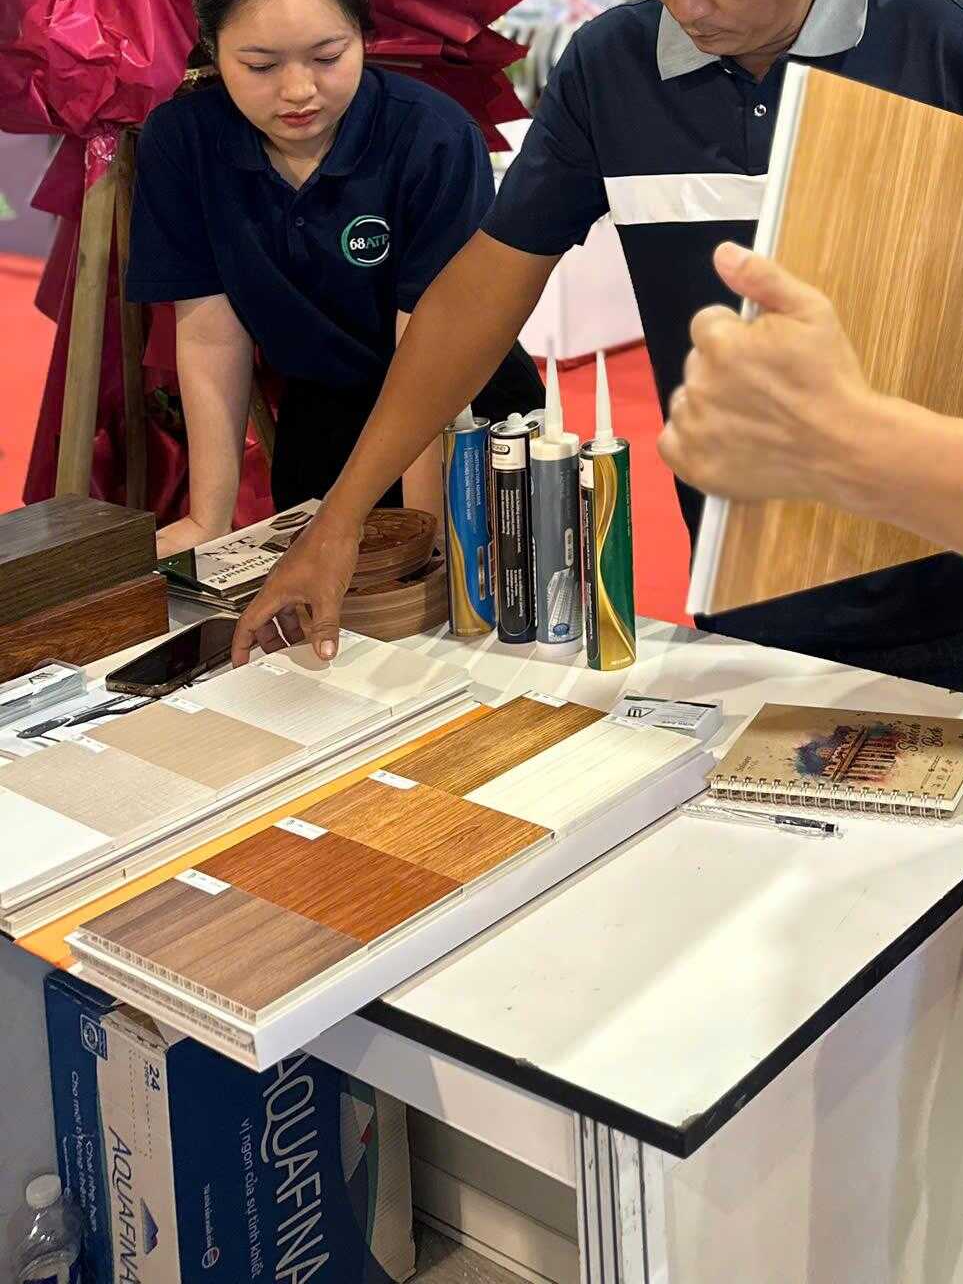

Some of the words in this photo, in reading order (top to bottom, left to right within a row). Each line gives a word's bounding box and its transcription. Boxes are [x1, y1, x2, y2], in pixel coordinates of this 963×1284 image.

[149, 1064, 161, 1093] 24
[108, 1125, 143, 1284] AQUAFINA
[260, 1051, 331, 1284] AQUAFINA
